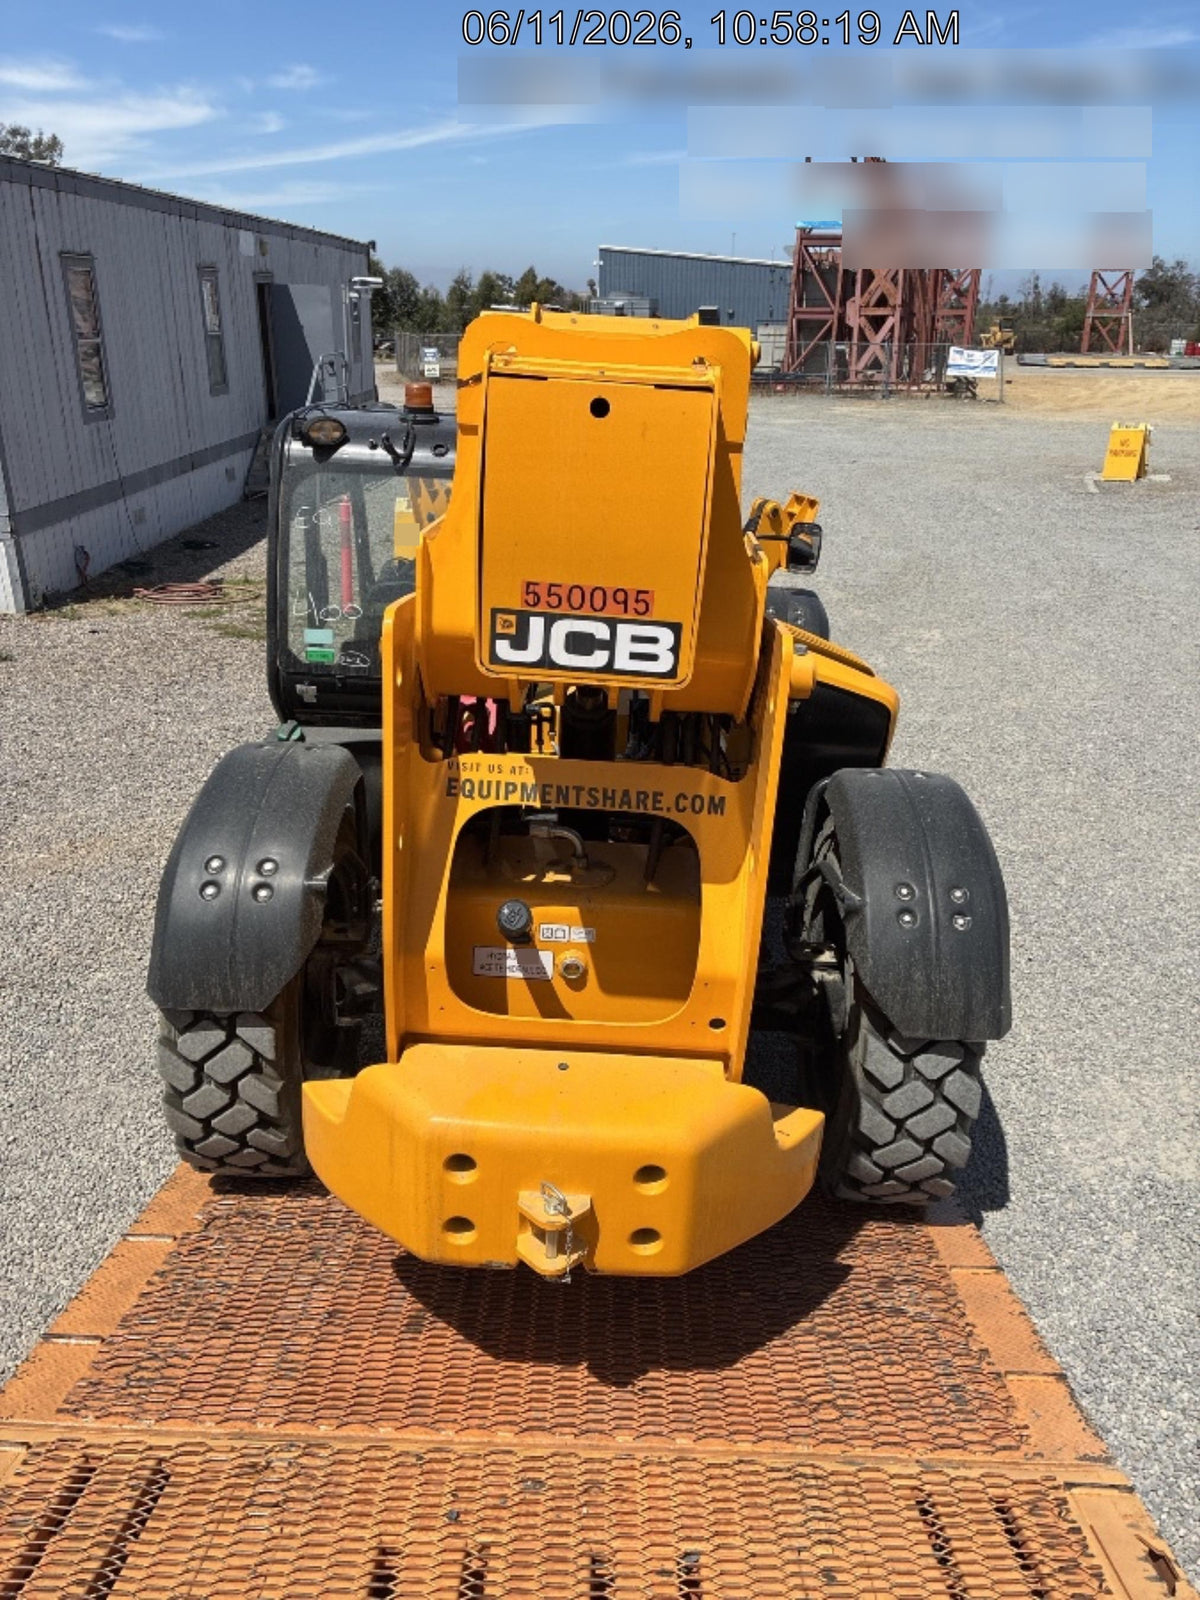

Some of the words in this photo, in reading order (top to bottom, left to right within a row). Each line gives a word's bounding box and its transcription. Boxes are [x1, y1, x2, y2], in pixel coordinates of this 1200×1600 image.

[524, 581, 651, 615] 550095
[495, 616, 675, 673] JCB
[447, 761, 481, 773] VISIT
[487, 763, 502, 774] US
[509, 765, 530, 776] AT:
[446, 778, 726, 816] EQUIPMENTSHARE.COM
